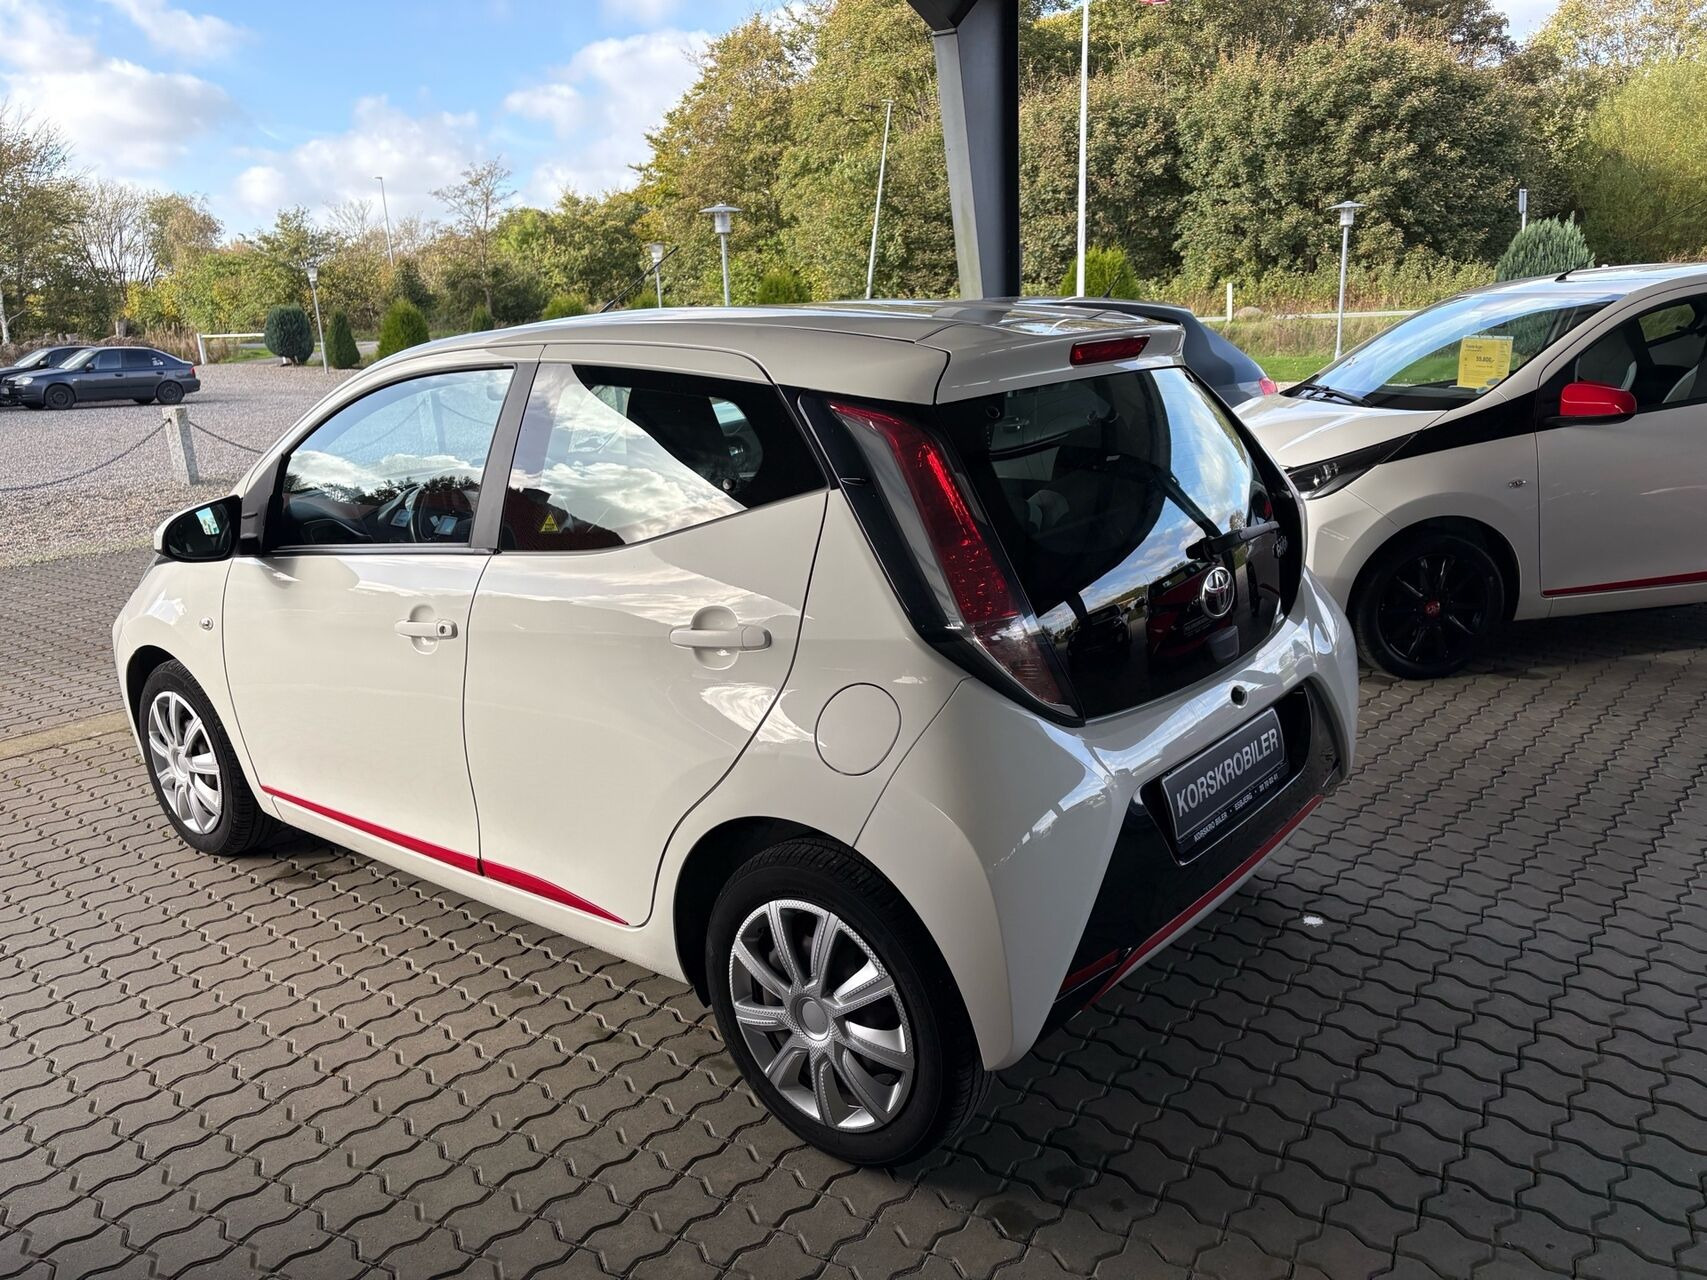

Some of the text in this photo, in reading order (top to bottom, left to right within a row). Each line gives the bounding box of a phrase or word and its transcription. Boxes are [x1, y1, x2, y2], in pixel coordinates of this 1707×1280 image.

[1176, 728, 1279, 817] KORSKROBILER
[1193, 820, 1216, 842] KORSKRO
[1214, 811, 1228, 826] BILER
[1234, 792, 1253, 810] ESBJERG
